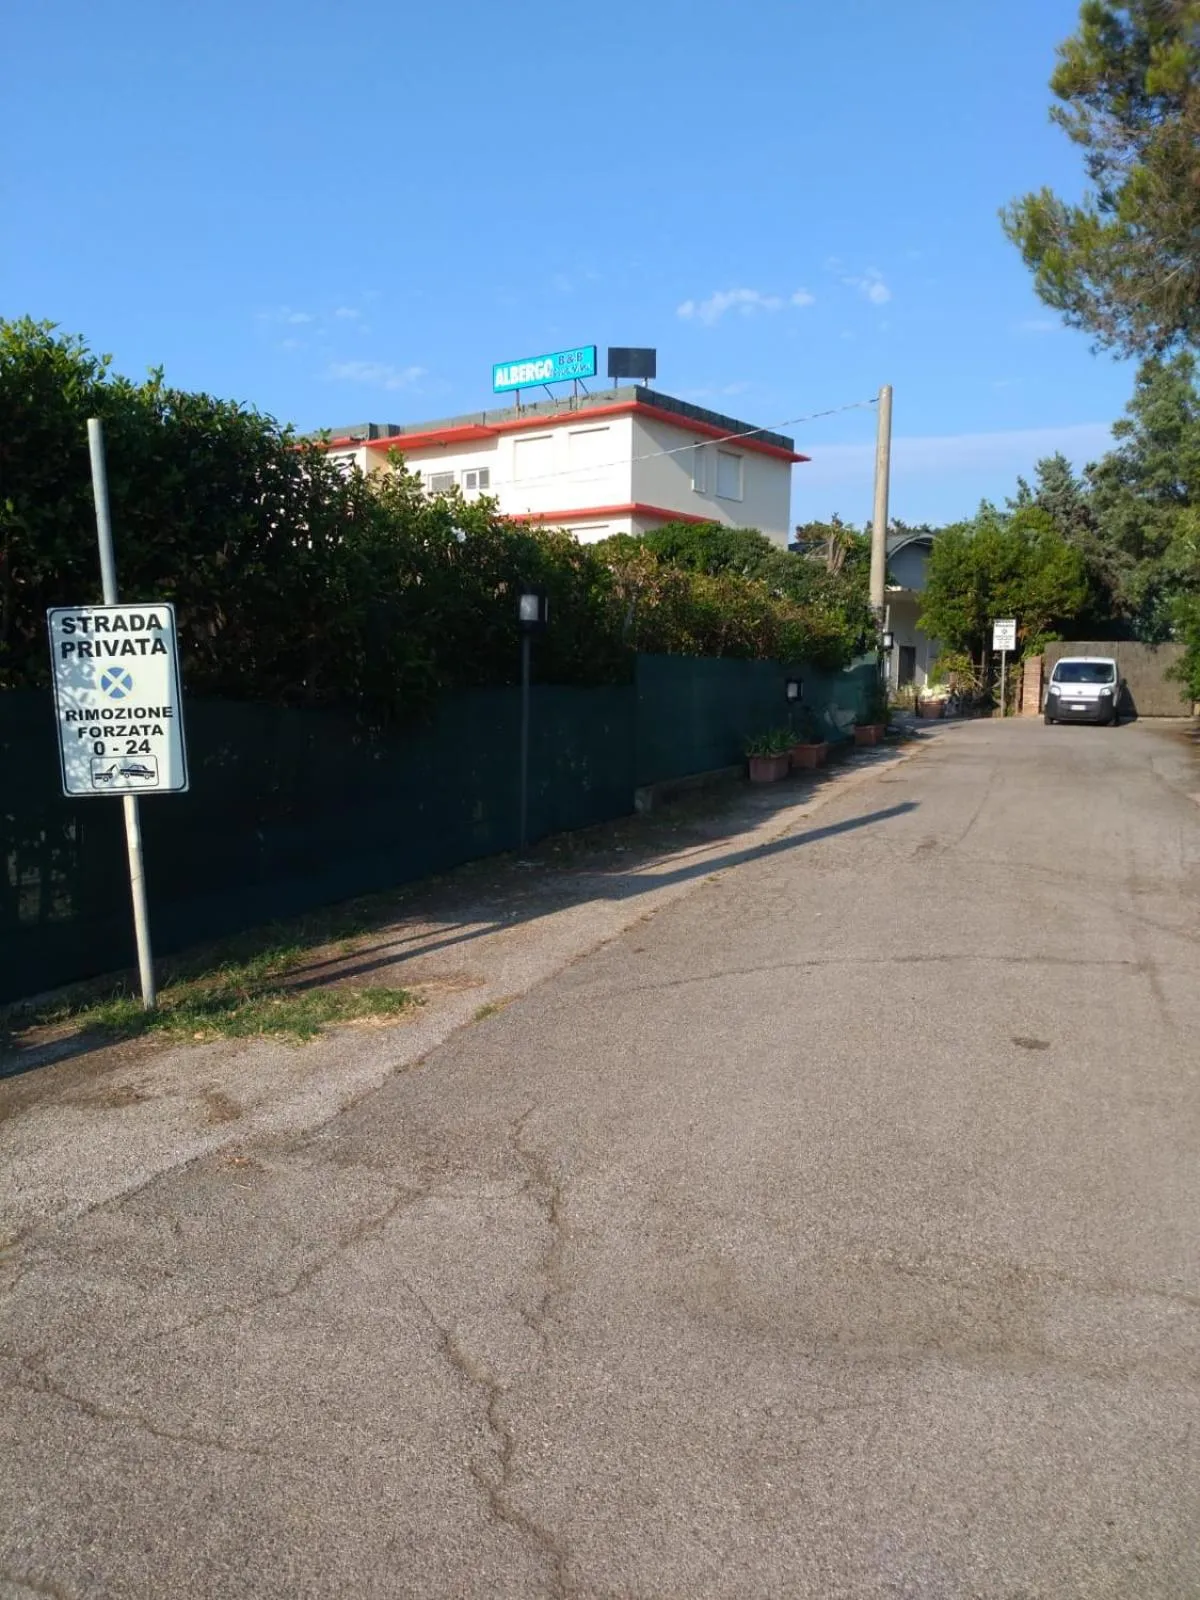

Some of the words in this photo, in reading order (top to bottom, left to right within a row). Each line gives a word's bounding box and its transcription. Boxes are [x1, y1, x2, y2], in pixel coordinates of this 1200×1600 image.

[558, 355, 565, 365] B
[576, 352, 584, 361] B
[495, 359, 553, 387] ALBERGO
[61, 614, 163, 634] STRADA
[61, 638, 168, 659] PRIVATA
[65, 706, 173, 722] RIMOZIONE
[78, 724, 164, 739] FORZATA
[93, 741, 106, 756] 0
[125, 739, 151, 755] 24
